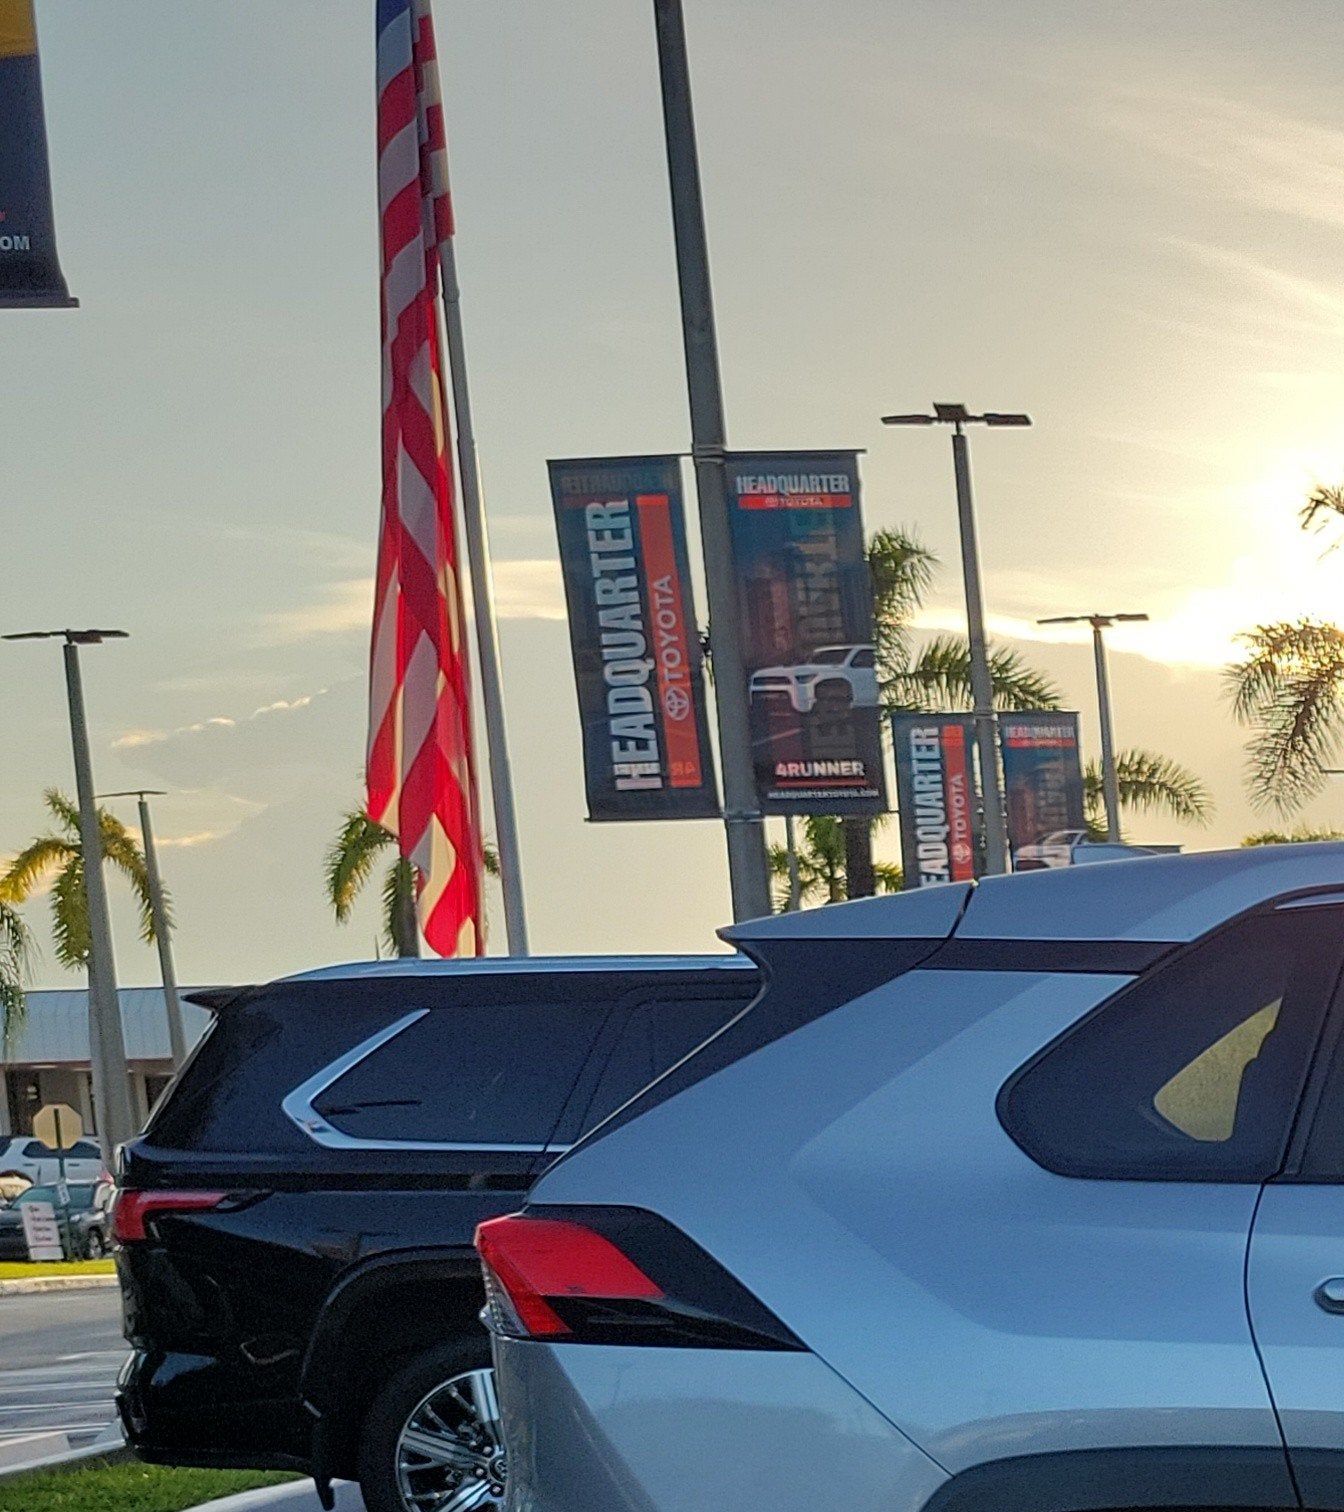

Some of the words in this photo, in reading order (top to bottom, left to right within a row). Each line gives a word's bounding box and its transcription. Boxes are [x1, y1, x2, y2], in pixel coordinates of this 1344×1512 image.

[736, 474, 850, 496] HEADQUARTER
[586, 499, 664, 791] HEADQUARTER
[653, 575, 690, 684] TOYOTA
[775, 760, 866, 778] 4RUNNER
[910, 726, 950, 887] EADQUARTER
[950, 774, 968, 841] TOYOTA
